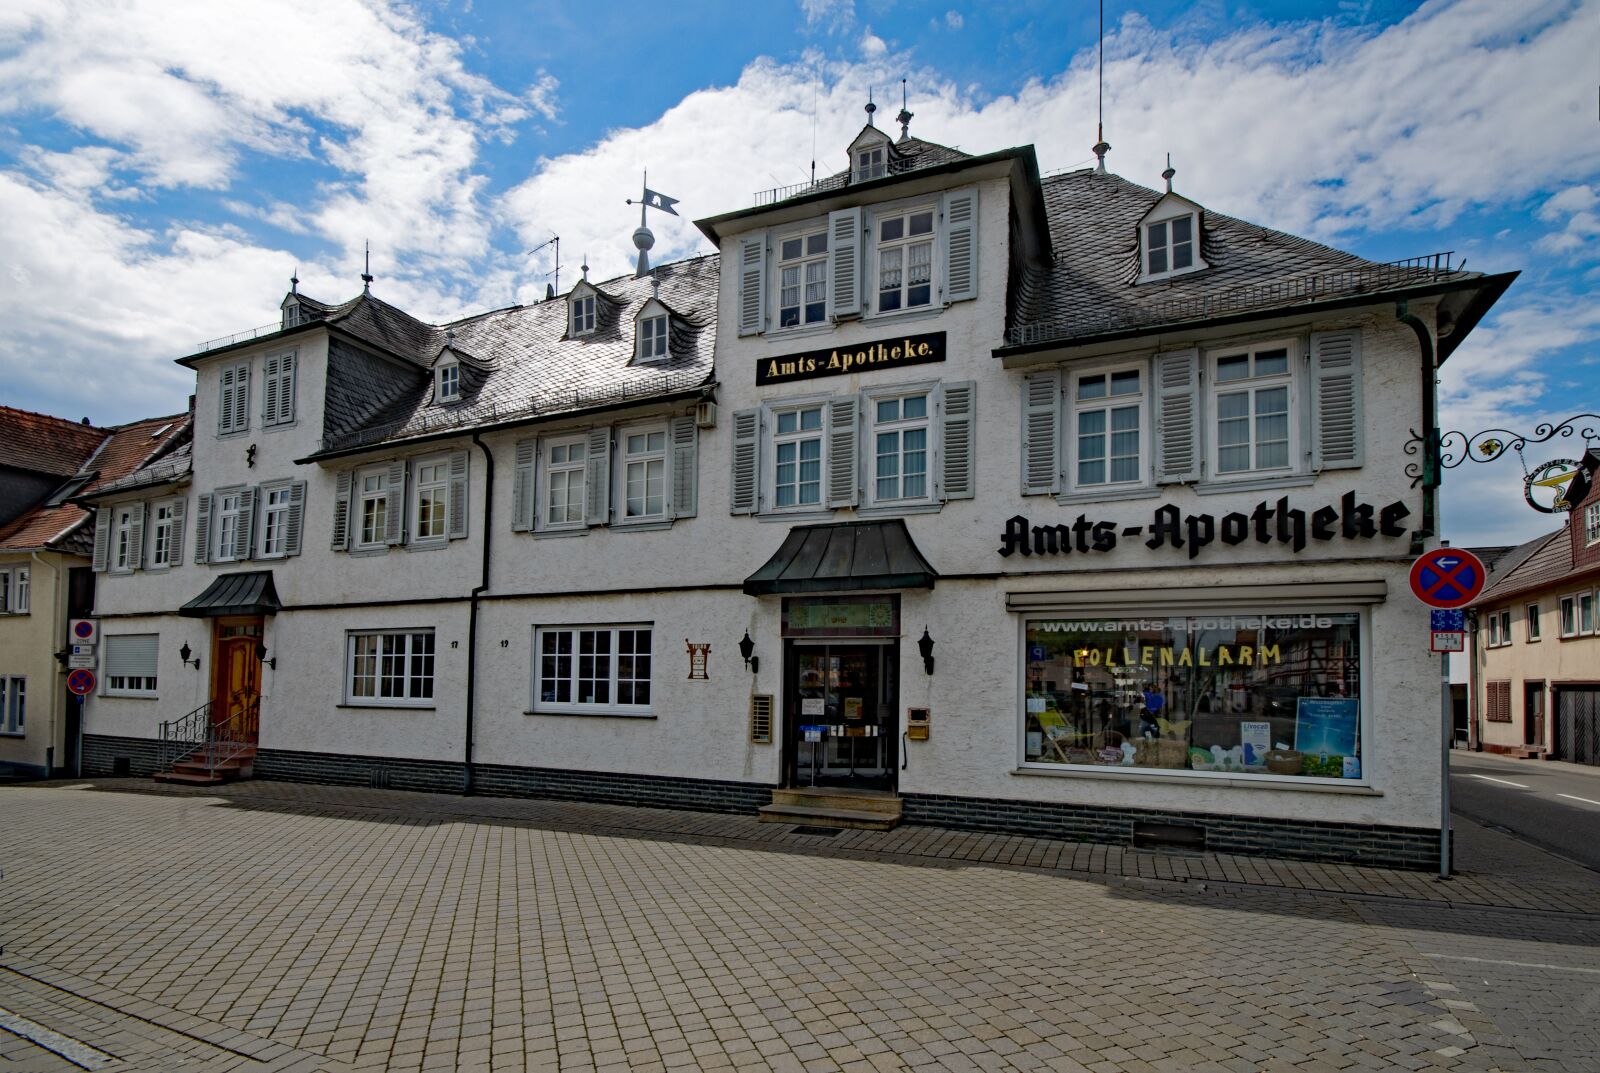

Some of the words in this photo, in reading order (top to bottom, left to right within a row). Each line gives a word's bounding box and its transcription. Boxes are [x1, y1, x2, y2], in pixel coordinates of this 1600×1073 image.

[998, 489, 1411, 560] Amts-Apotheke
[1042, 614, 1333, 634] www.amts-apotheke.de
[450, 640, 459, 649] 17
[500, 639, 509, 648] 19
[1073, 644, 1282, 668] POLLENALARM
